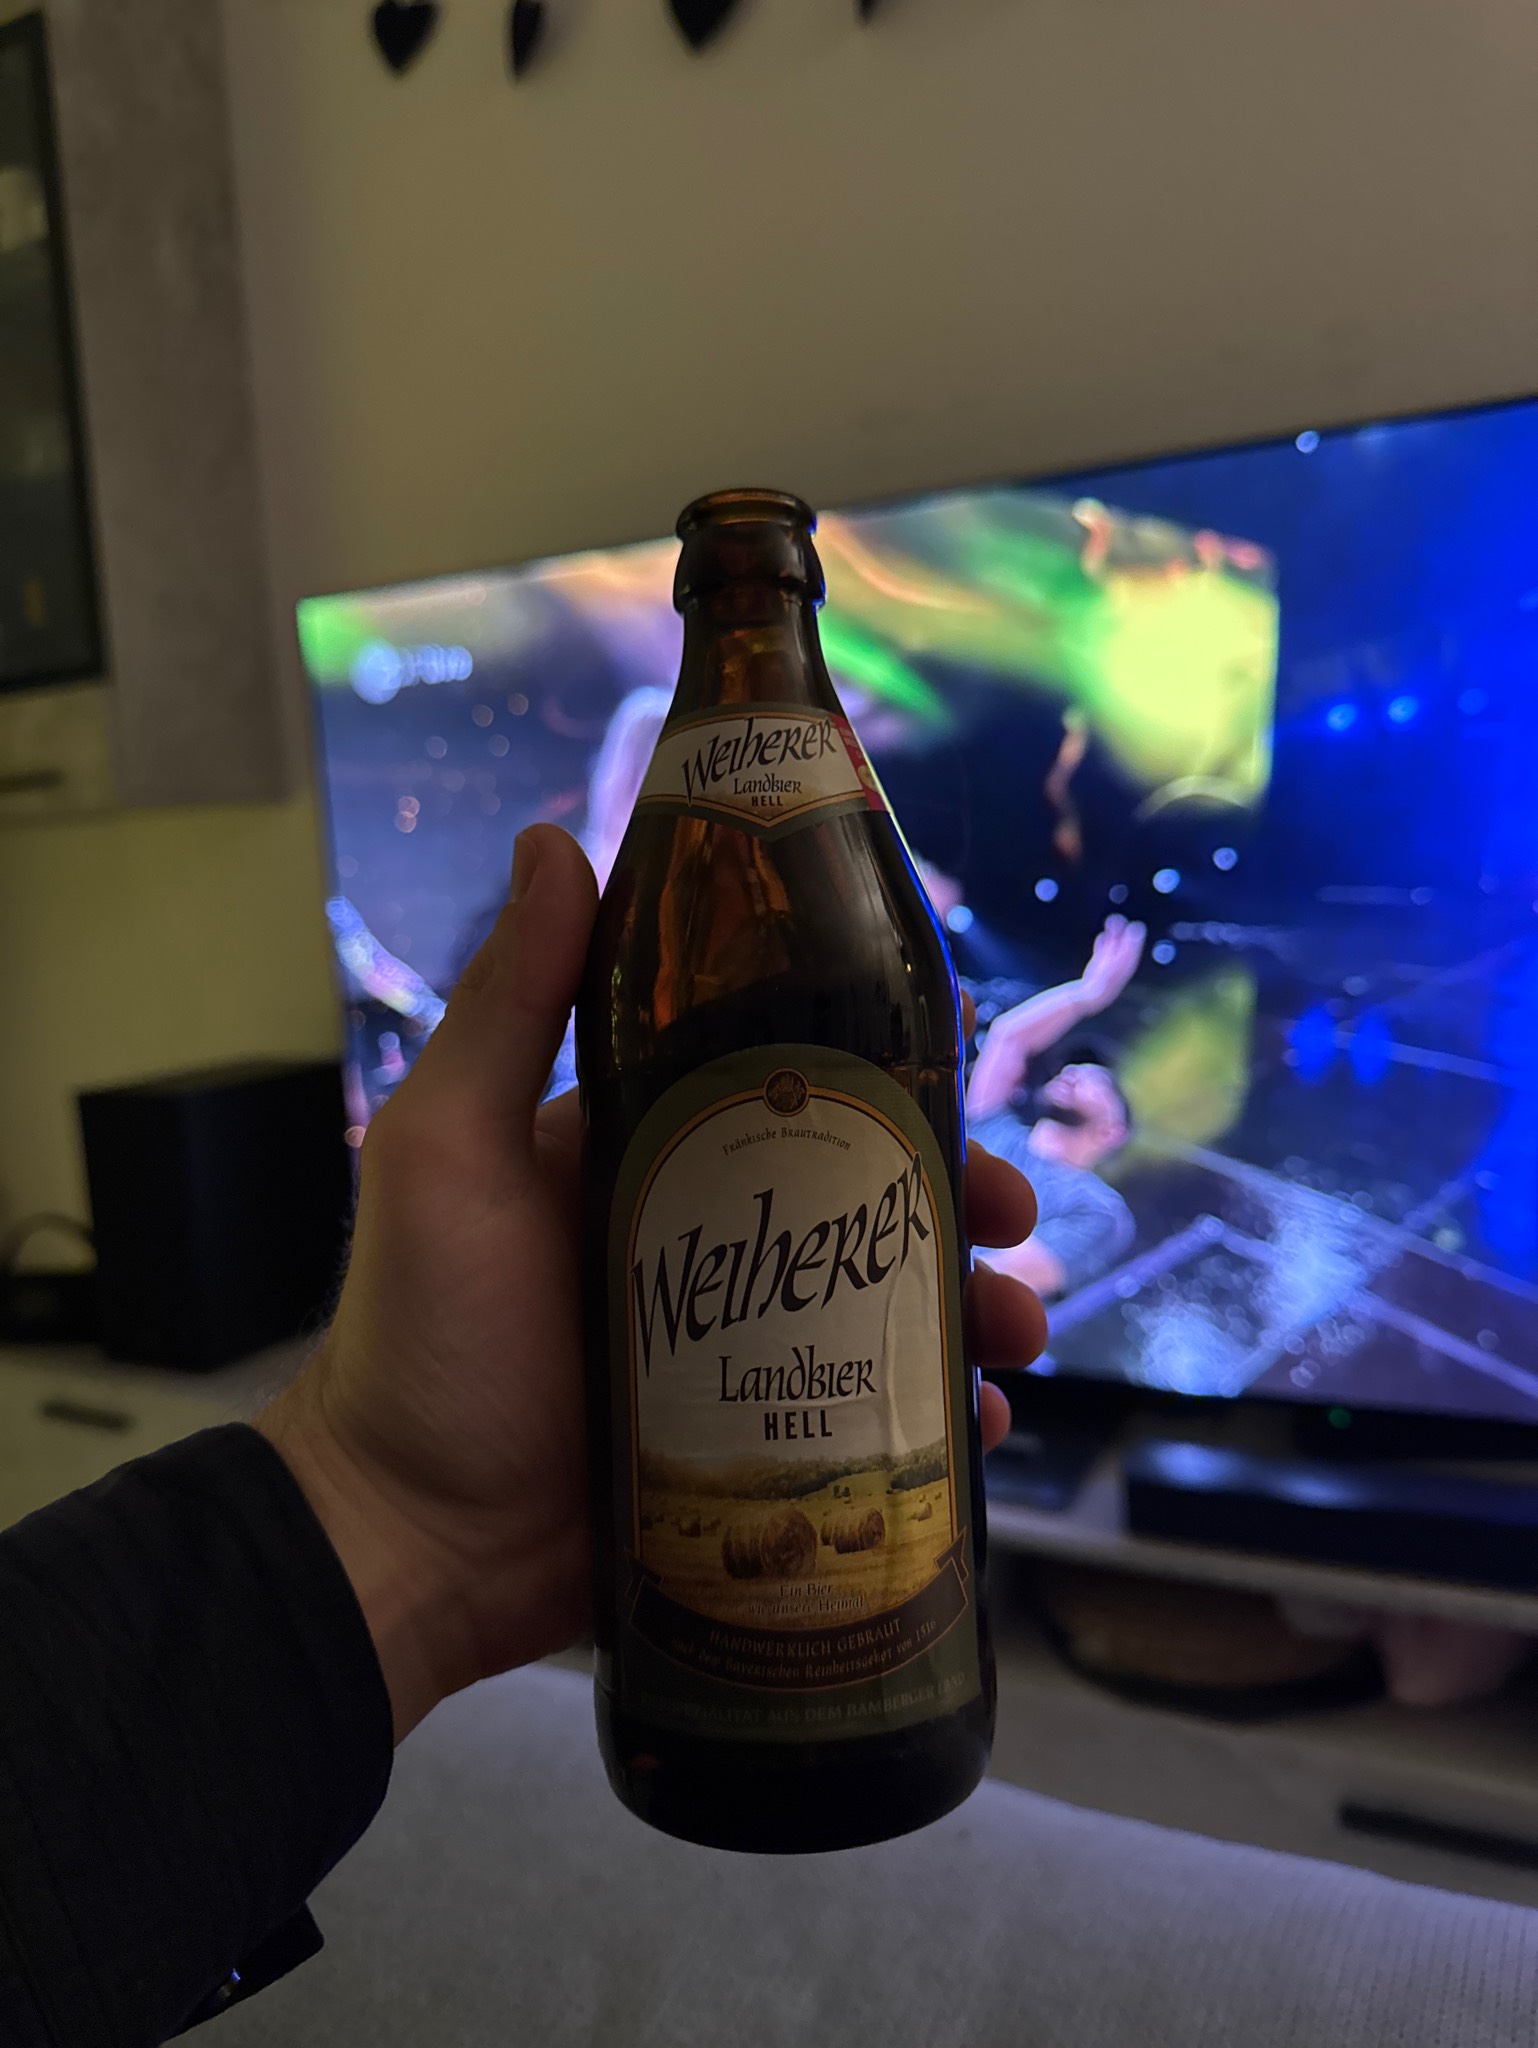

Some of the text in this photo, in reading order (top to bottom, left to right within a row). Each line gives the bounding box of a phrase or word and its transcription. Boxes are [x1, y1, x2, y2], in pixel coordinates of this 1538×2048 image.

[681, 716, 836, 806] Weiherer
[734, 773, 802, 796] Landbier
[751, 796, 783, 807] HELL
[722, 1126, 851, 1156] Fränkische Brautradition
[631, 1152, 930, 1378] Weiherer
[718, 1345, 877, 1402] Landbier
[764, 1409, 833, 1440] HELL
[780, 1582, 833, 1597] Ein Bier
[709, 1617, 901, 1659] HANDWERKLICH GEBRAUT
[804, 1705, 843, 1723] DEM
[847, 1685, 936, 1718] BAMBERGER
